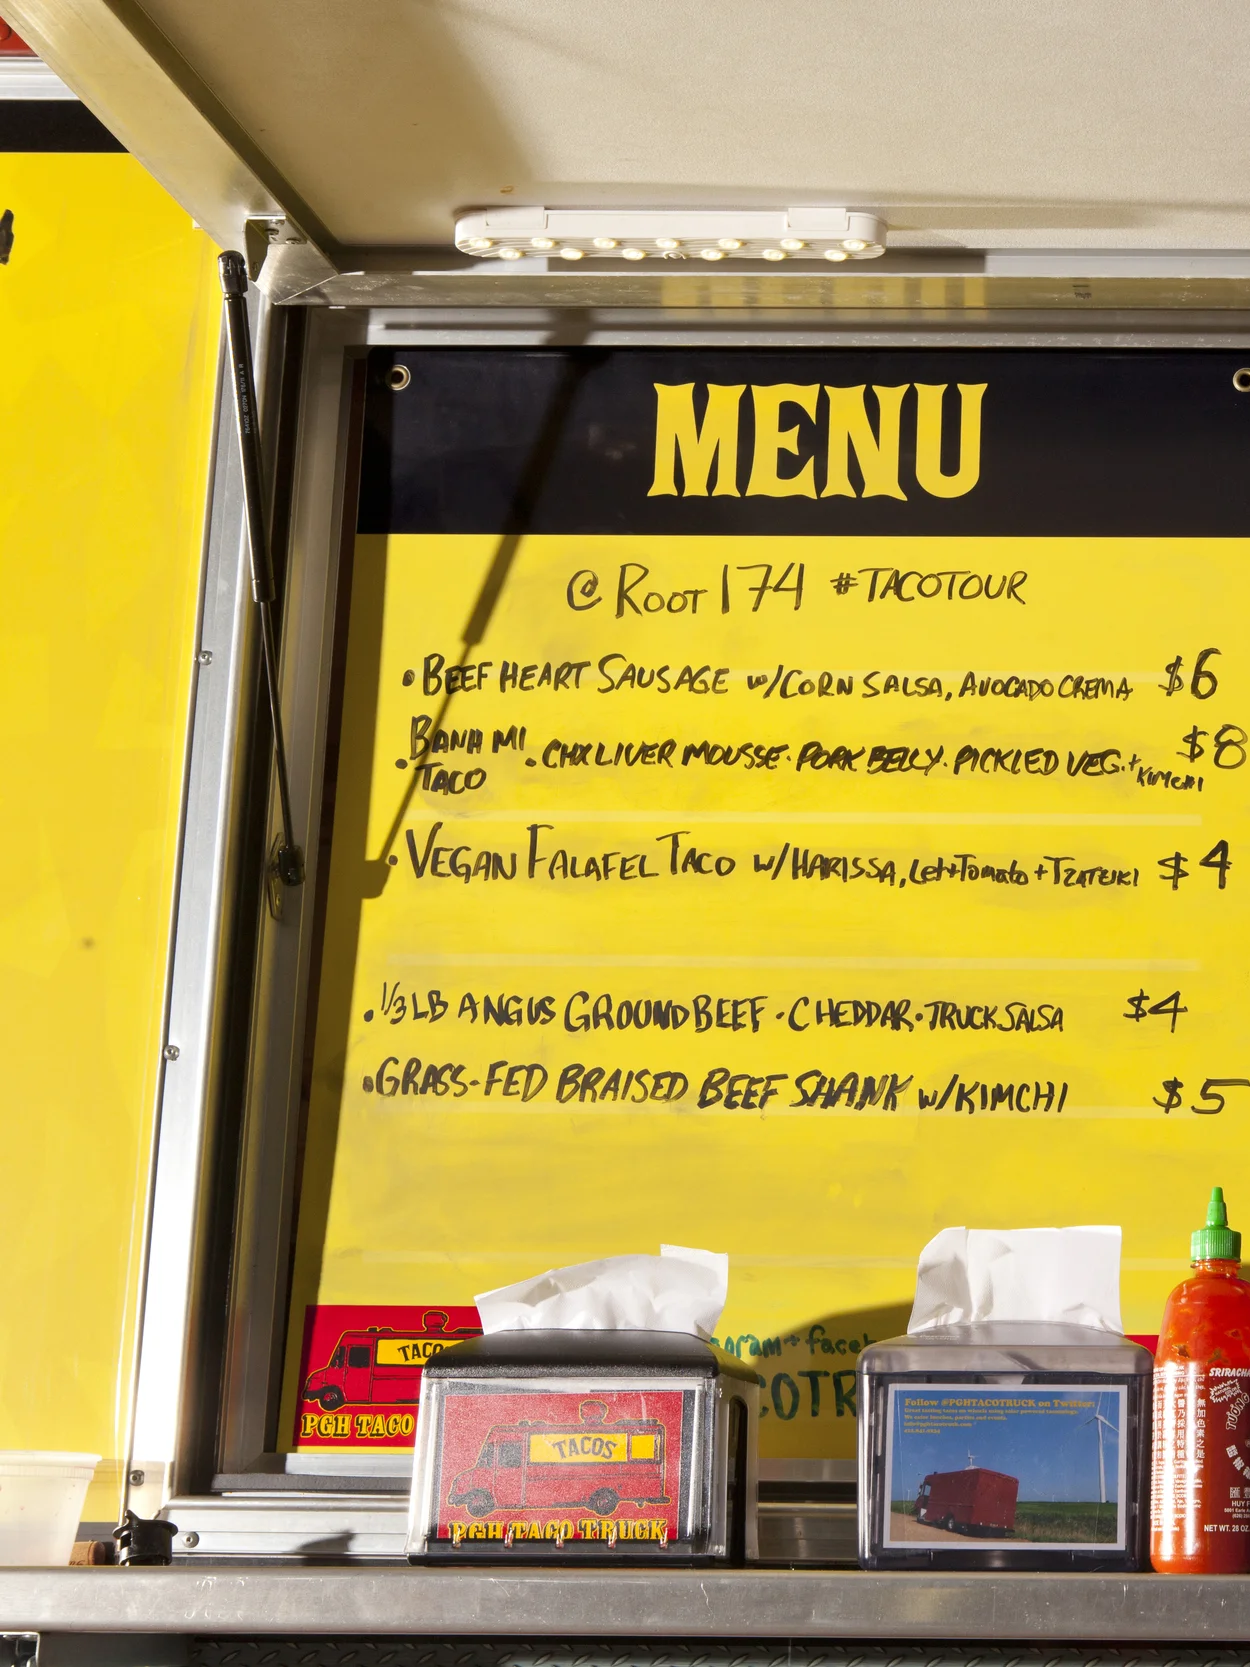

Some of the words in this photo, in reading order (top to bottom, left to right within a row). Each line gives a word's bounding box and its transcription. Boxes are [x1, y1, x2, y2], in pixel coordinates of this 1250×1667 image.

[647, 382, 988, 501] MENU
[720, 562, 805, 615] 174
[830, 567, 1028, 605] #TACOTOUR
[422, 652, 493, 696] BEEF
[499, 660, 591, 693] HEART
[596, 653, 730, 695] SAUSAGE
[1158, 647, 1223, 700] $6
[410, 714, 482, 761] BANH
[491, 726, 527, 754] MI
[1175, 723, 1249, 770] $8
[418, 762, 487, 796] TACO
[405, 821, 517, 884] VEGAN
[526, 824, 660, 881] FALAFEL
[656, 830, 737, 876] TACO
[1157, 839, 1232, 891] $4
[412, 989, 448, 1022] LB
[458, 992, 557, 1027] ANGUS
[788, 996, 914, 1032] CHEDDAR
[1122, 988, 1188, 1033] $4
[375, 1056, 548, 1102] GRASS-FED
[555, 1066, 689, 1104] BRAISED
[697, 1067, 788, 1110] BEEF
[788, 1069, 914, 1112] SHANK
[397, 1341, 449, 1363] TACO
[300, 1413, 351, 1438] PGH
[355, 1413, 414, 1438] TACO
[904, 1398, 939, 1407] Follow
[941, 1398, 1037, 1408] @PGHTACOTRUCK
[552, 1436, 618, 1460] TACOS
[448, 1519, 504, 1540] PGH
[510, 1518, 575, 1540] TACO
[577, 1517, 668, 1540] TRUCK
[1203, 1524, 1218, 1532] NET
[1219, 1524, 1231, 1532] WT.
[1231, 1524, 1239, 1532] 28
